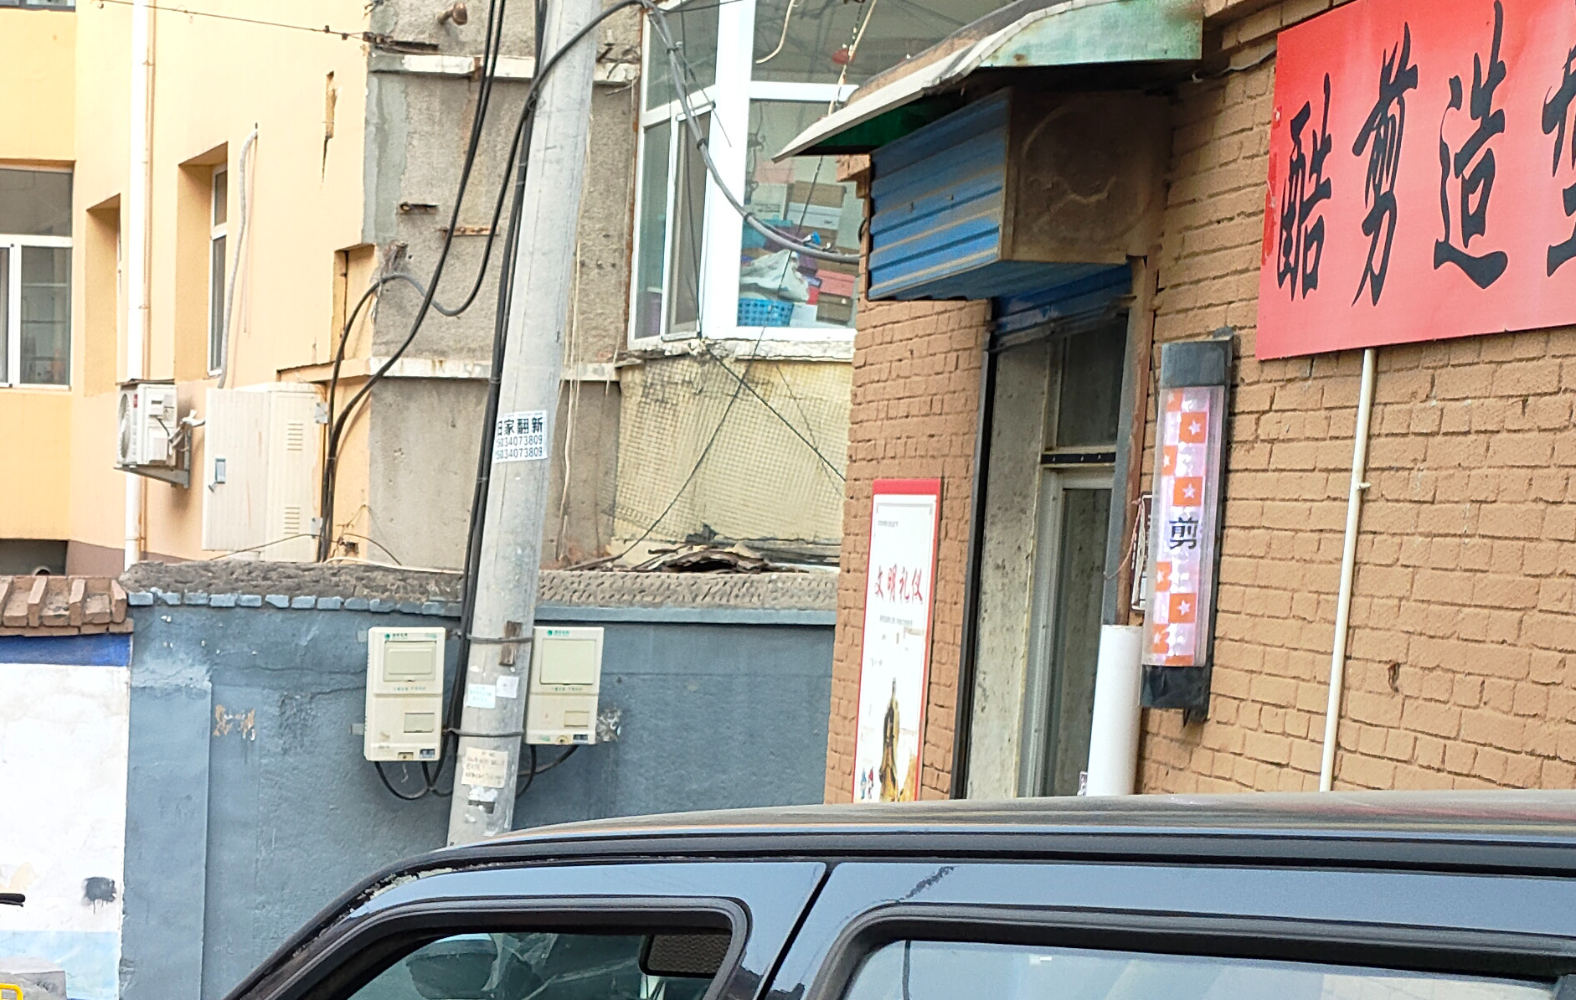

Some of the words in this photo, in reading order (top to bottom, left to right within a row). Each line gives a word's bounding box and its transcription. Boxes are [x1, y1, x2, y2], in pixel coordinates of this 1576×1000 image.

[1169, 517, 1199, 550] 剪
[874, 563, 923, 604] 文明礼仪
